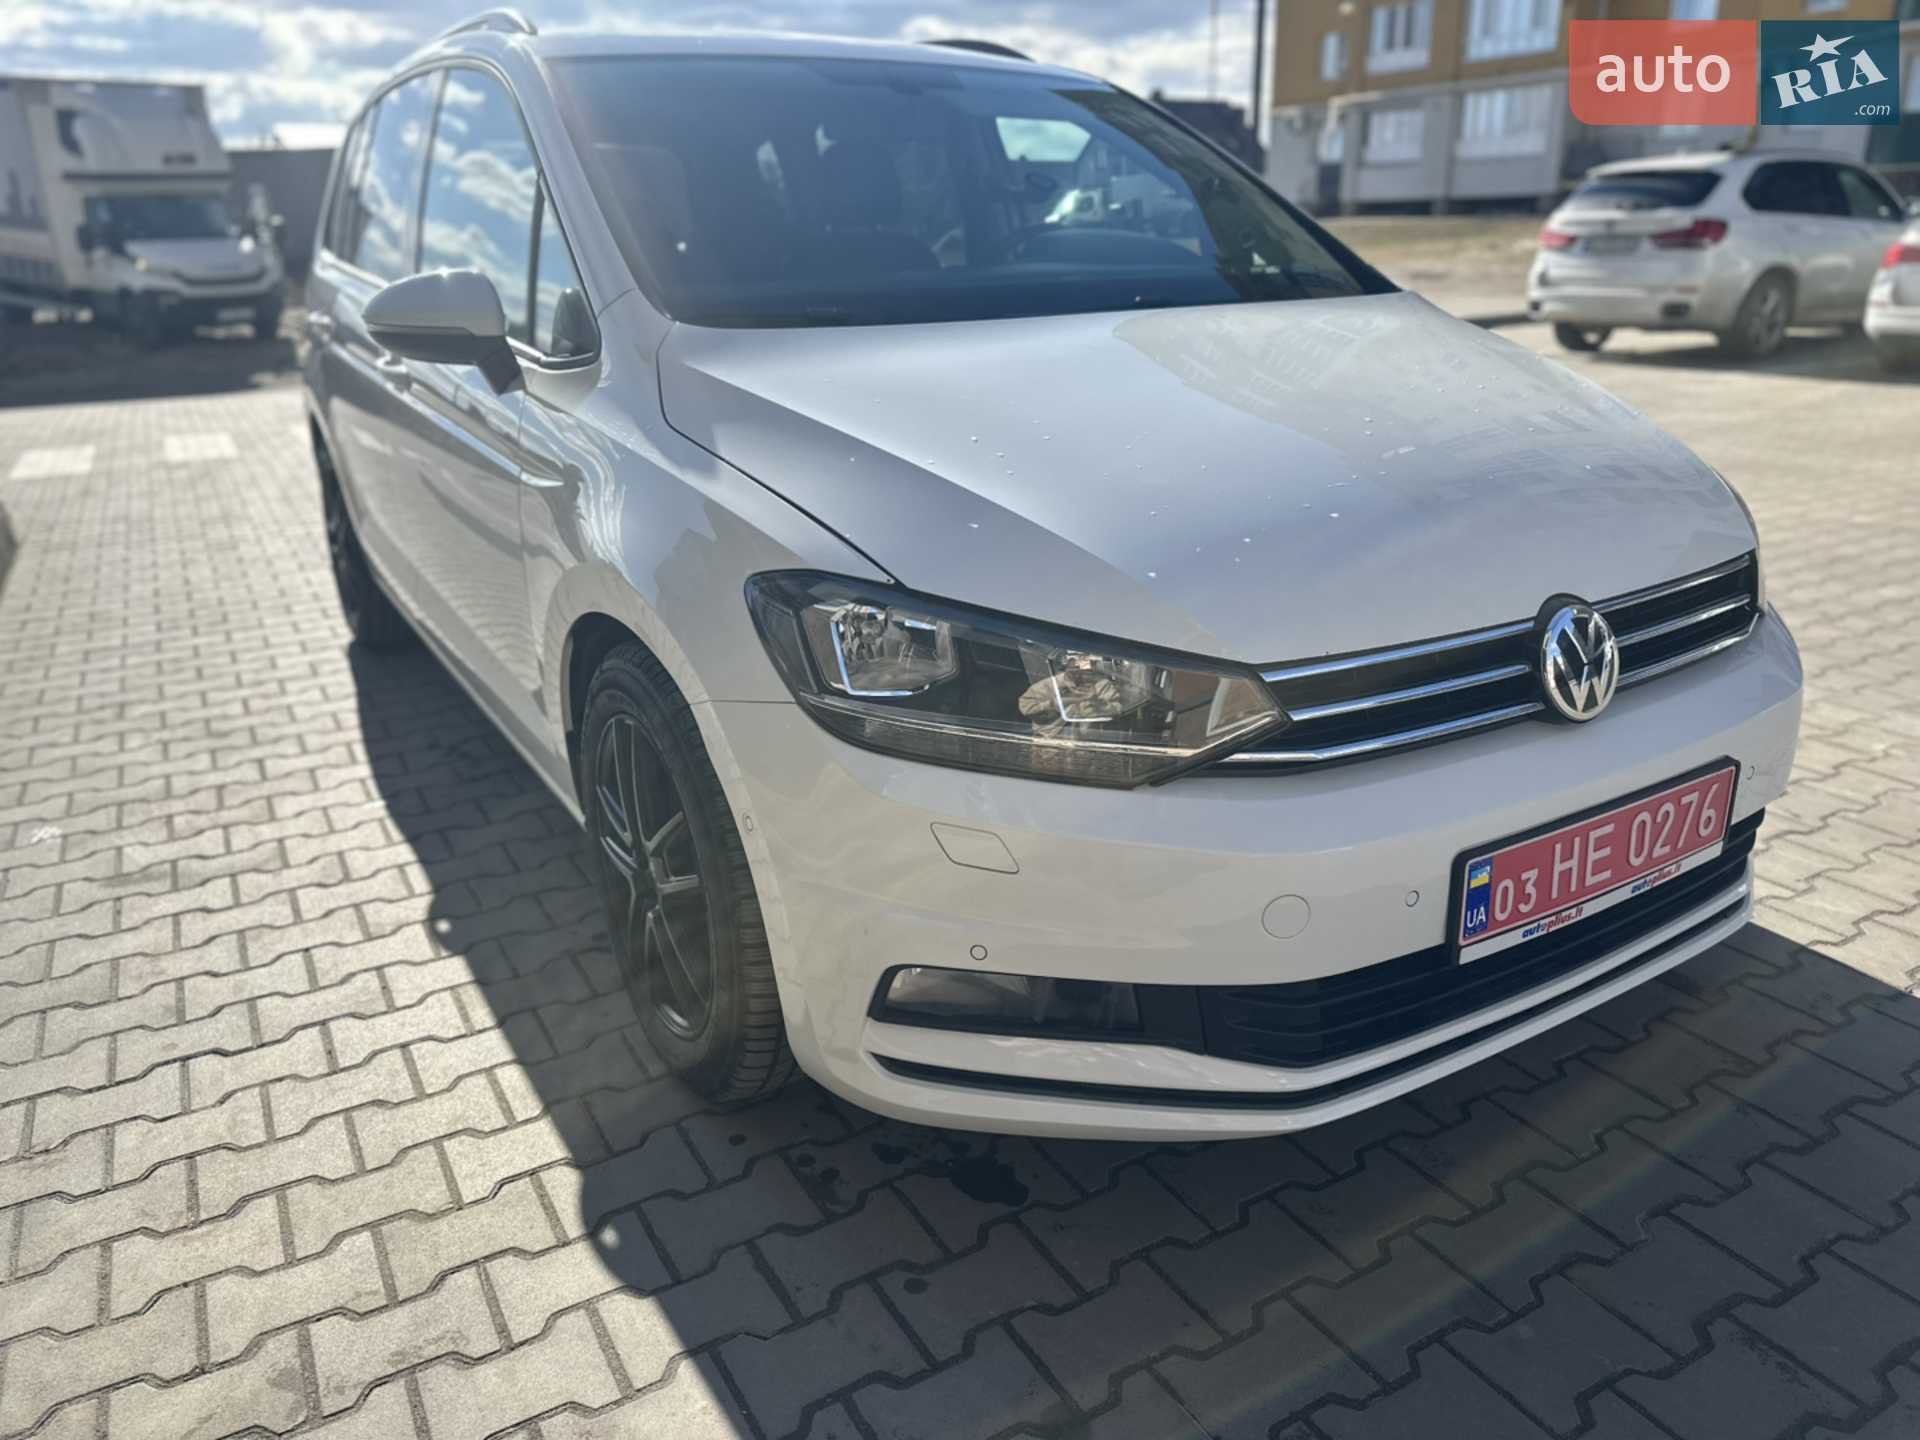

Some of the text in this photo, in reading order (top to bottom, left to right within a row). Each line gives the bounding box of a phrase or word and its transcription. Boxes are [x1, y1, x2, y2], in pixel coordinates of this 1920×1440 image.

[1494, 781, 1720, 922] 03 HE 0276
[1631, 862, 1682, 894] autoplius.lt
[1466, 905, 1487, 928] UA
[1522, 906, 1584, 939] autoplius.lt
